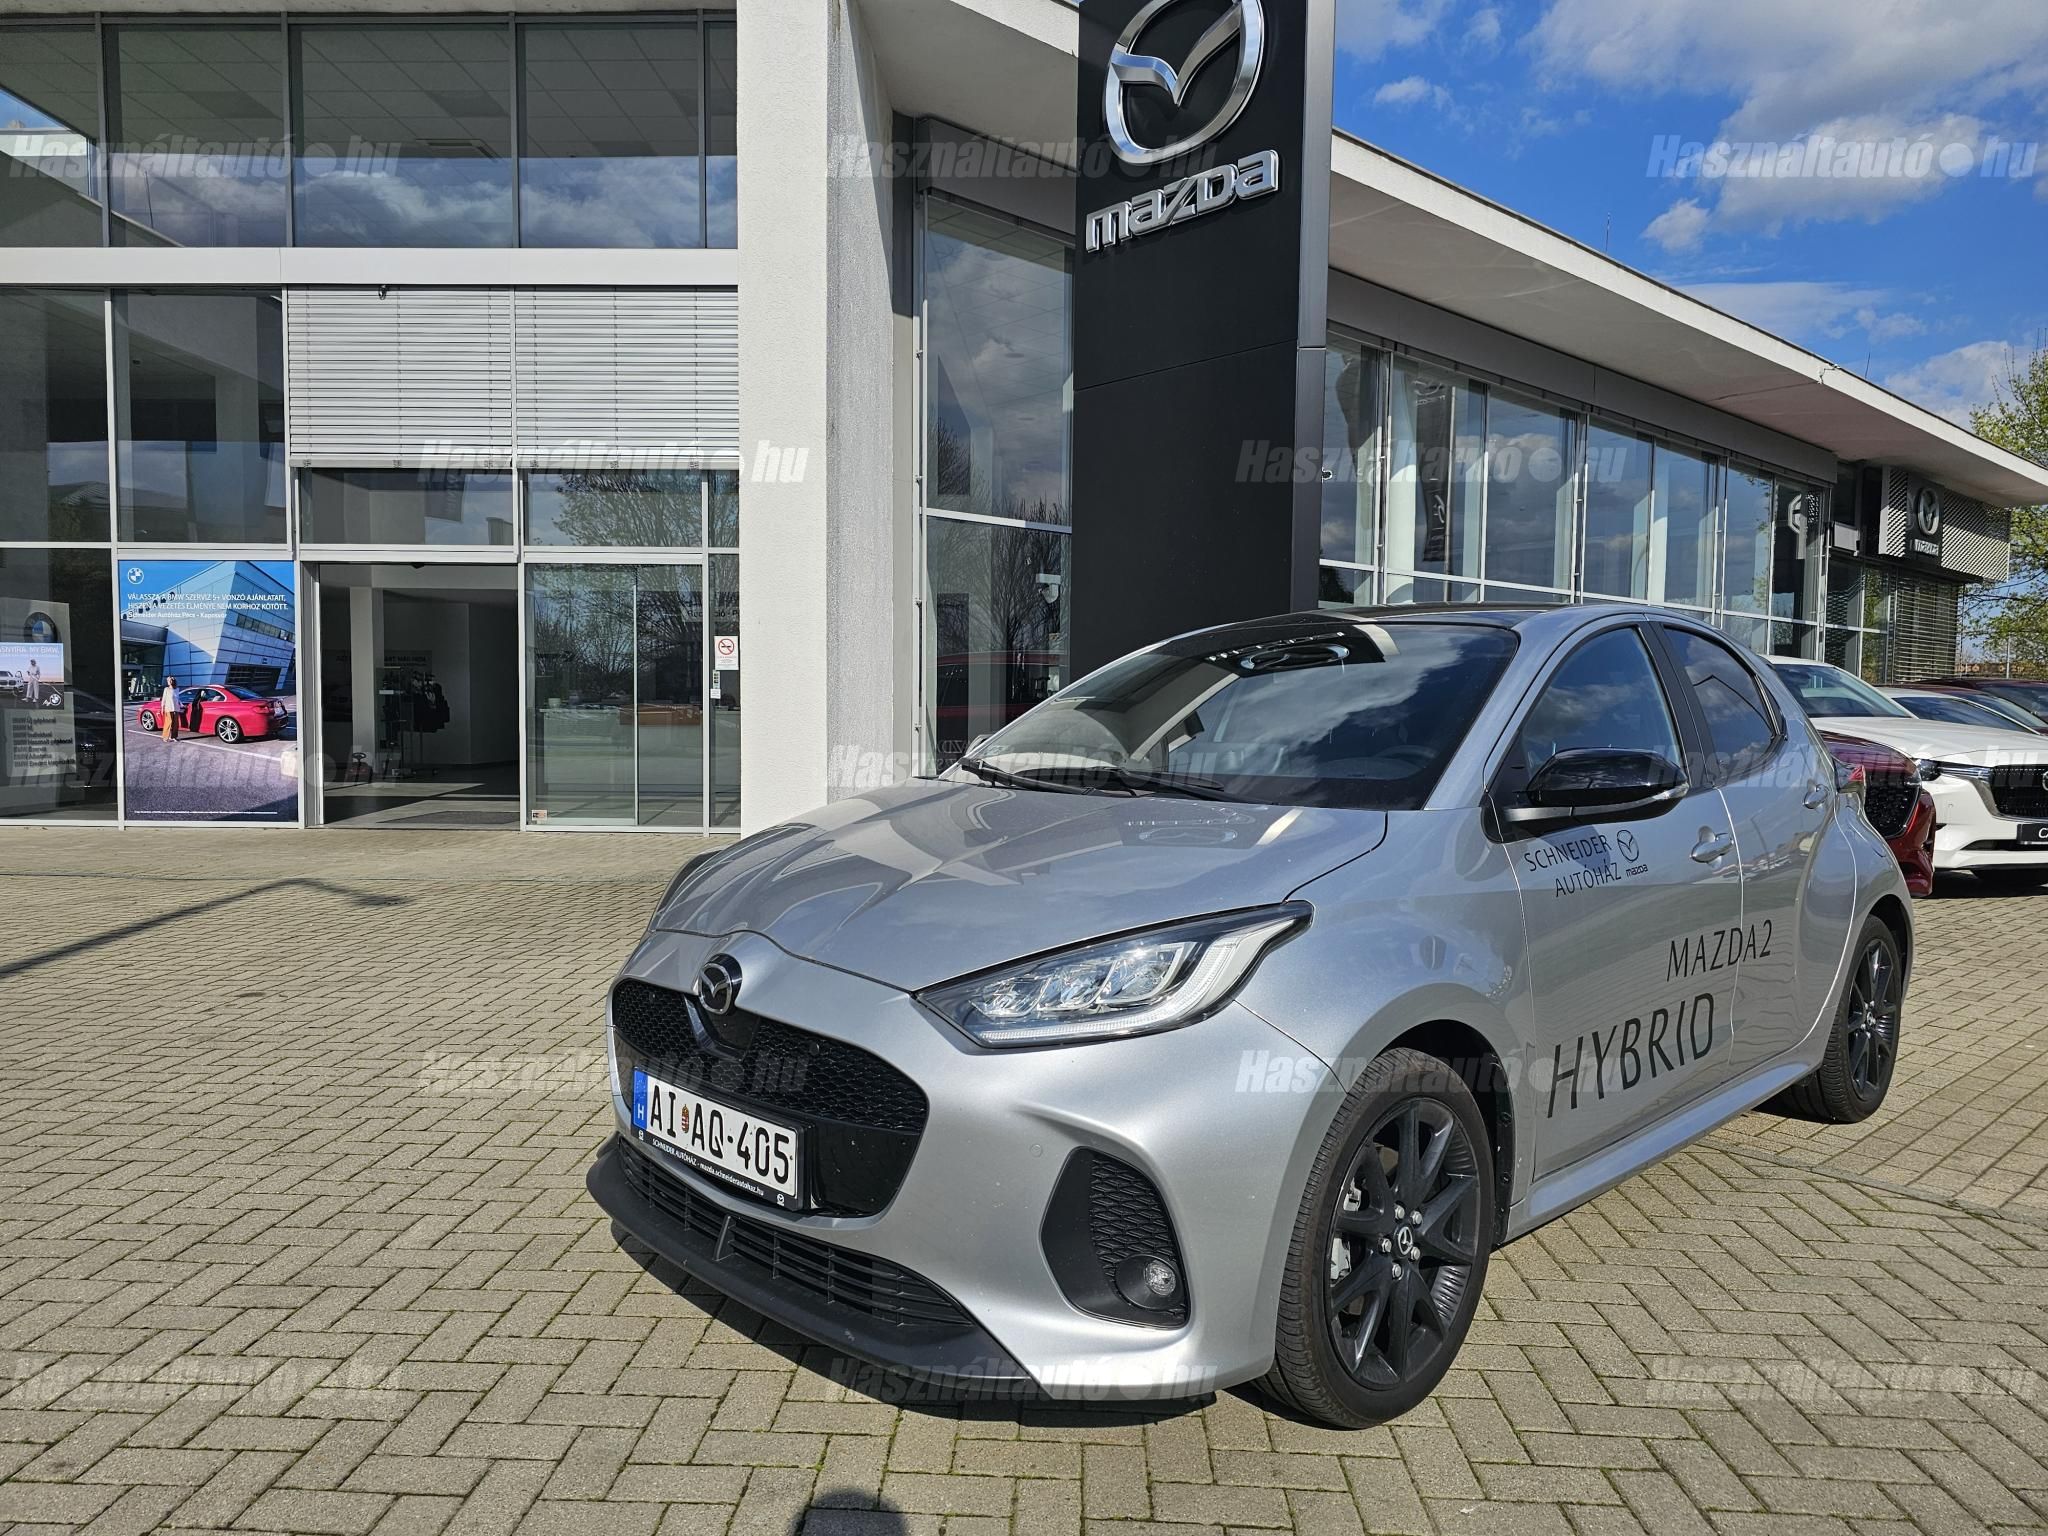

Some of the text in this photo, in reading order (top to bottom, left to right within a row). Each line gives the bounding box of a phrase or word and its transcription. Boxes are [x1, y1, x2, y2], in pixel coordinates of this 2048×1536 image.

[1524, 834, 1613, 872] SCHNEIDER
[1555, 858, 1622, 898] AUTÓHÁZ
[1667, 919, 1772, 981] MAZDA2
[1547, 992, 1715, 1118] HYBRID
[637, 1103, 645, 1121] H
[652, 1138, 676, 1156] SCHNEIDER
[676, 1150, 697, 1167] AUTÓHÁZ
